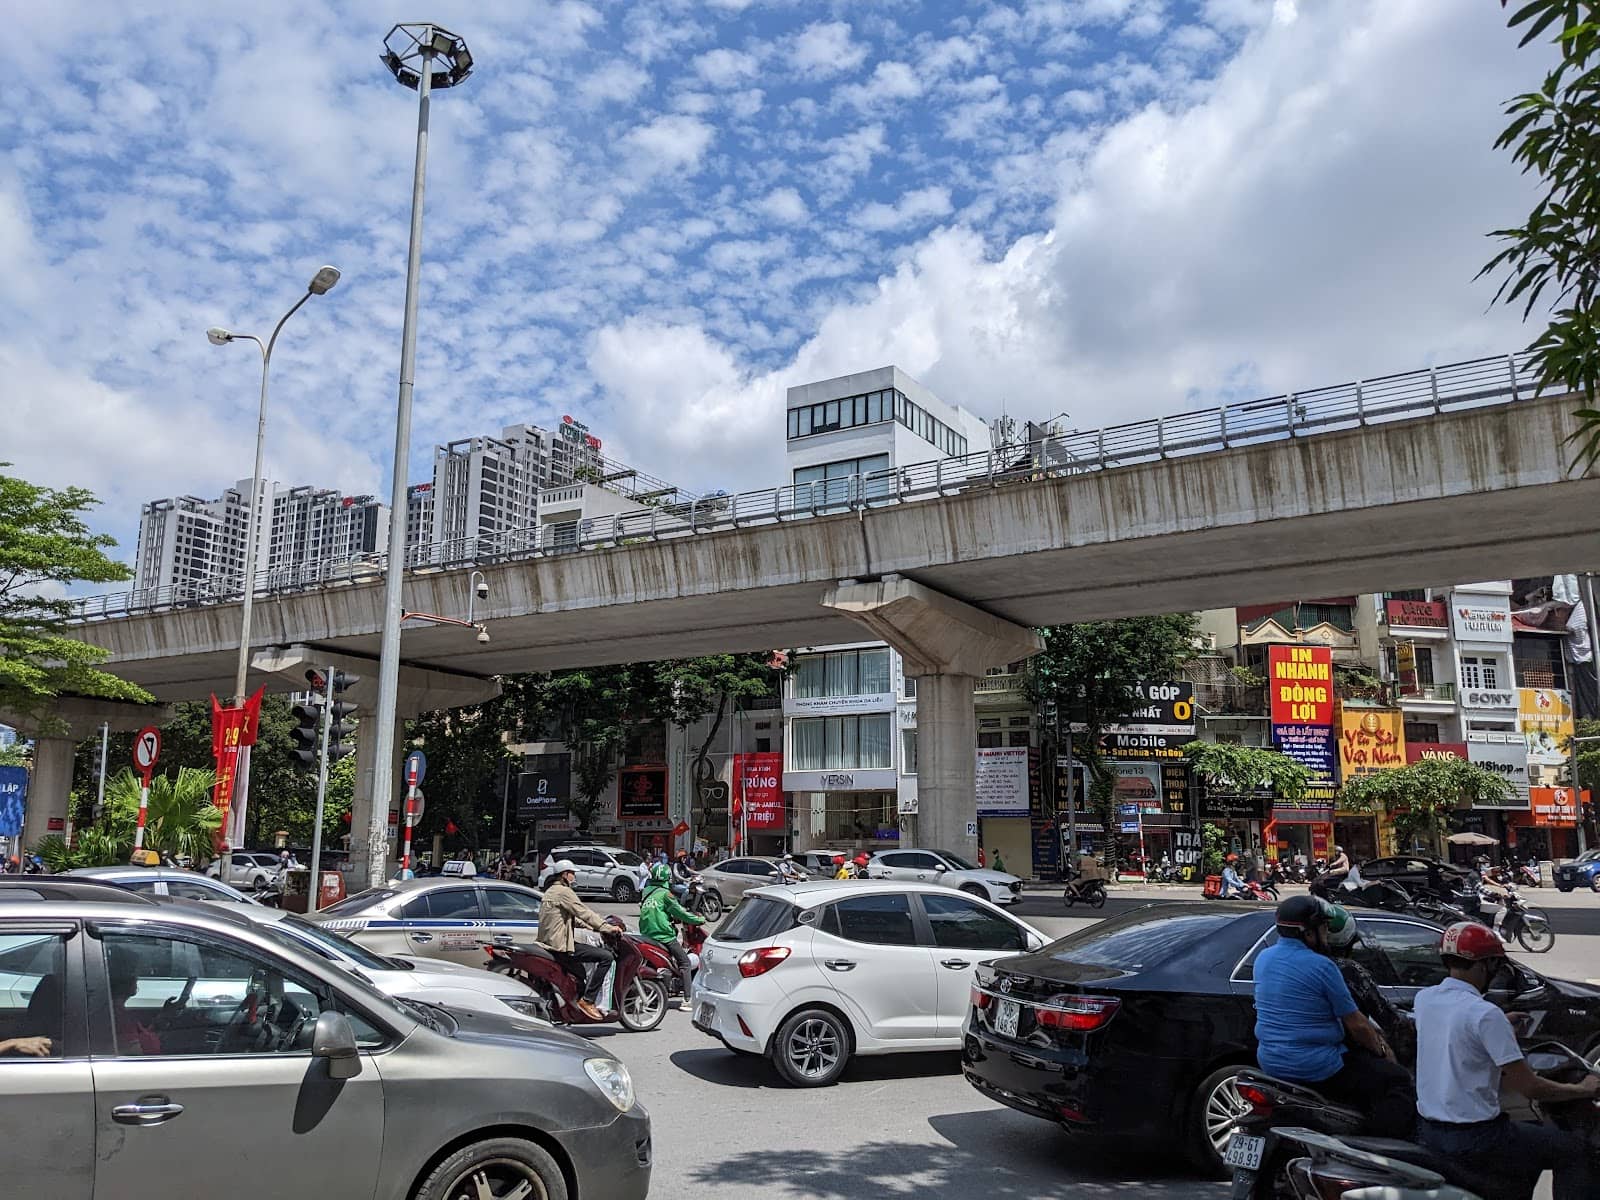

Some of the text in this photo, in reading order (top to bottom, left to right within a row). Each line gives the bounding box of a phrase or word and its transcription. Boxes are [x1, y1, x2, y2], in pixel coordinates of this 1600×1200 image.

[1291, 648, 1312, 662] IN
[1276, 661, 1329, 680] NHANH
[1149, 682, 1180, 701] GÓP
[1280, 681, 1327, 702] ĐỒNG
[1469, 693, 1512, 704] SONY
[1291, 702, 1317, 723] LỢI
[1117, 735, 1167, 747] Mobile
[821, 774, 854, 785] YERSIN
[1, 782, 19, 795] LẬP
[1175, 847, 1201, 864] GÓP
[1232, 1135, 1259, 1152] 29-G1
